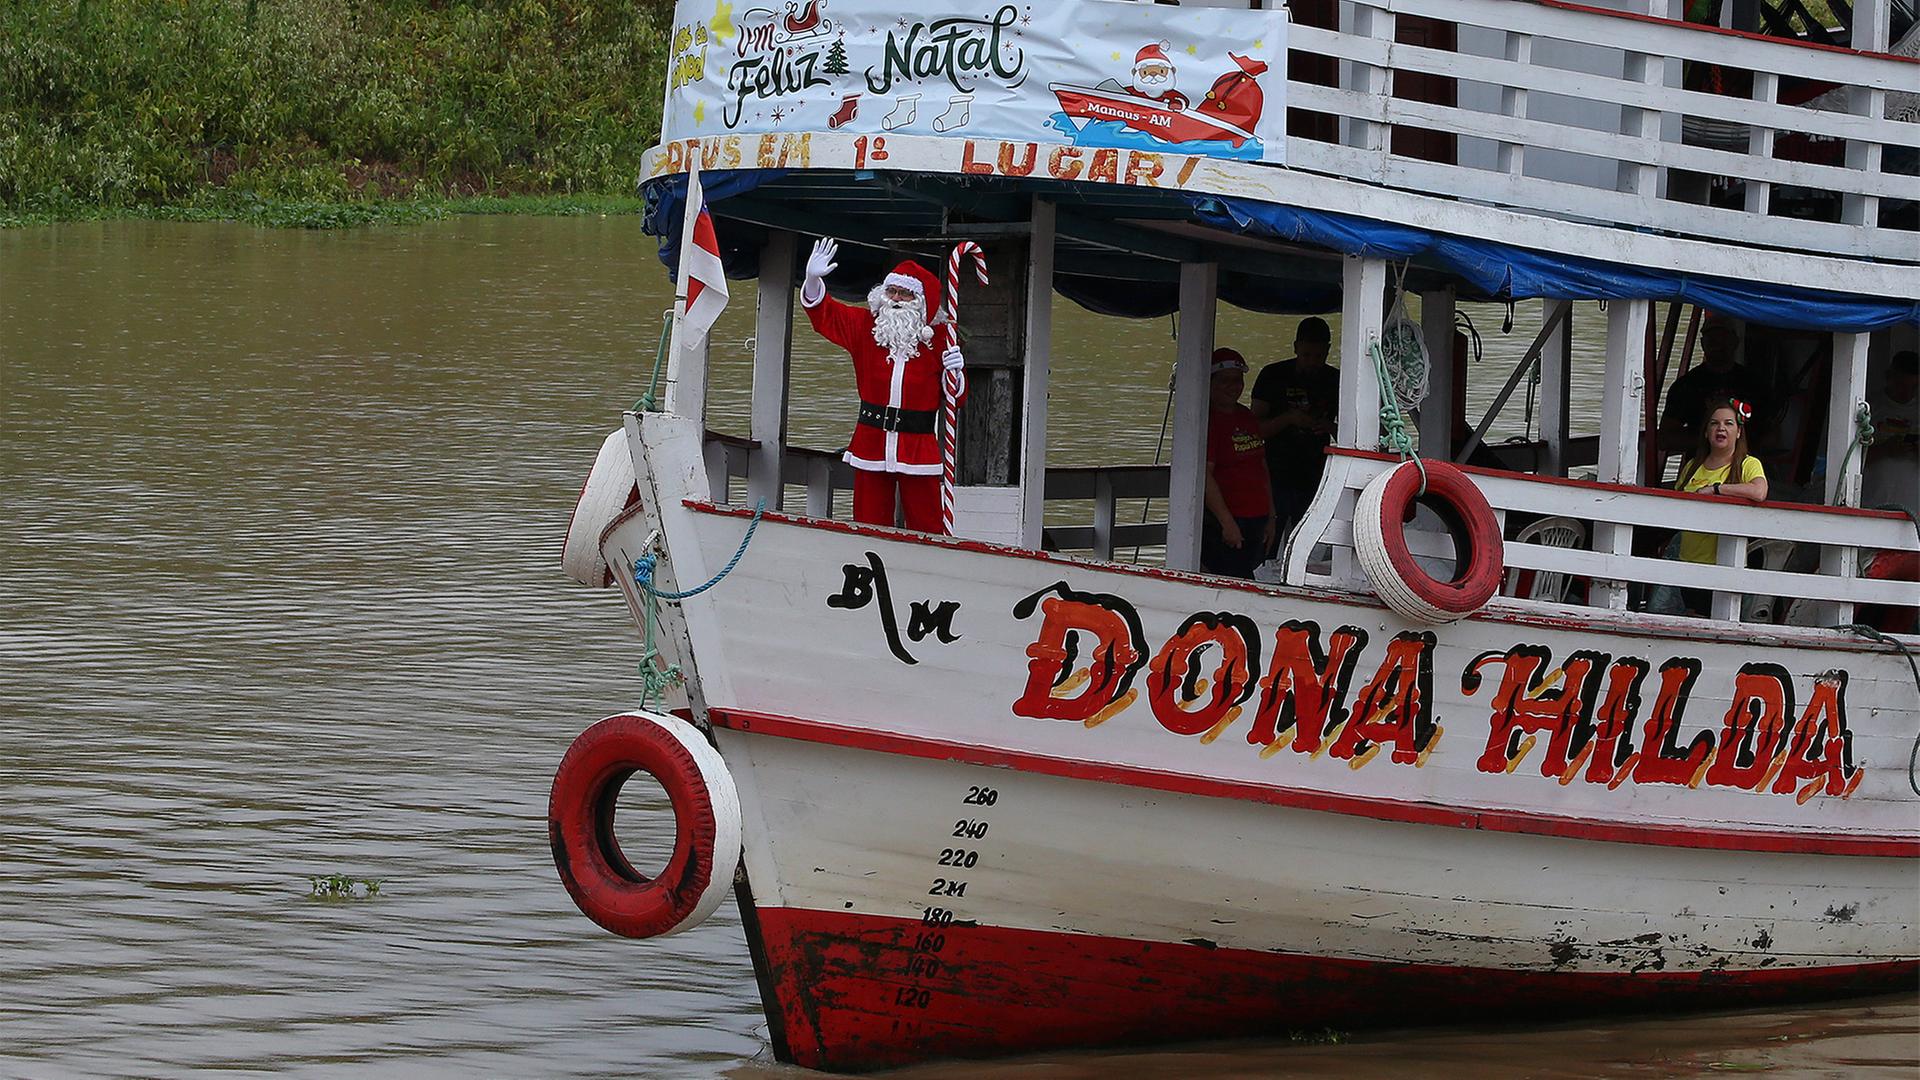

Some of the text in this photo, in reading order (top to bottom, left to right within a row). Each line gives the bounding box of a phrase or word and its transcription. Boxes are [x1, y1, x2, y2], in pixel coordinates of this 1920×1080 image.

[723, 5, 1024, 129] Feliz Natal
[1087, 102, 1140, 121] Manaus
[1148, 114, 1172, 128] AM
[757, 132, 812, 169] EM
[1011, 580, 1445, 771] DONA
[1460, 643, 1865, 805] HILDA
[962, 785, 998, 807] 260
[952, 818, 989, 840] 240
[937, 848, 979, 869] 220
[928, 878, 968, 898] 2M
[921, 906, 954, 929] 180
[914, 932, 945, 954] 160
